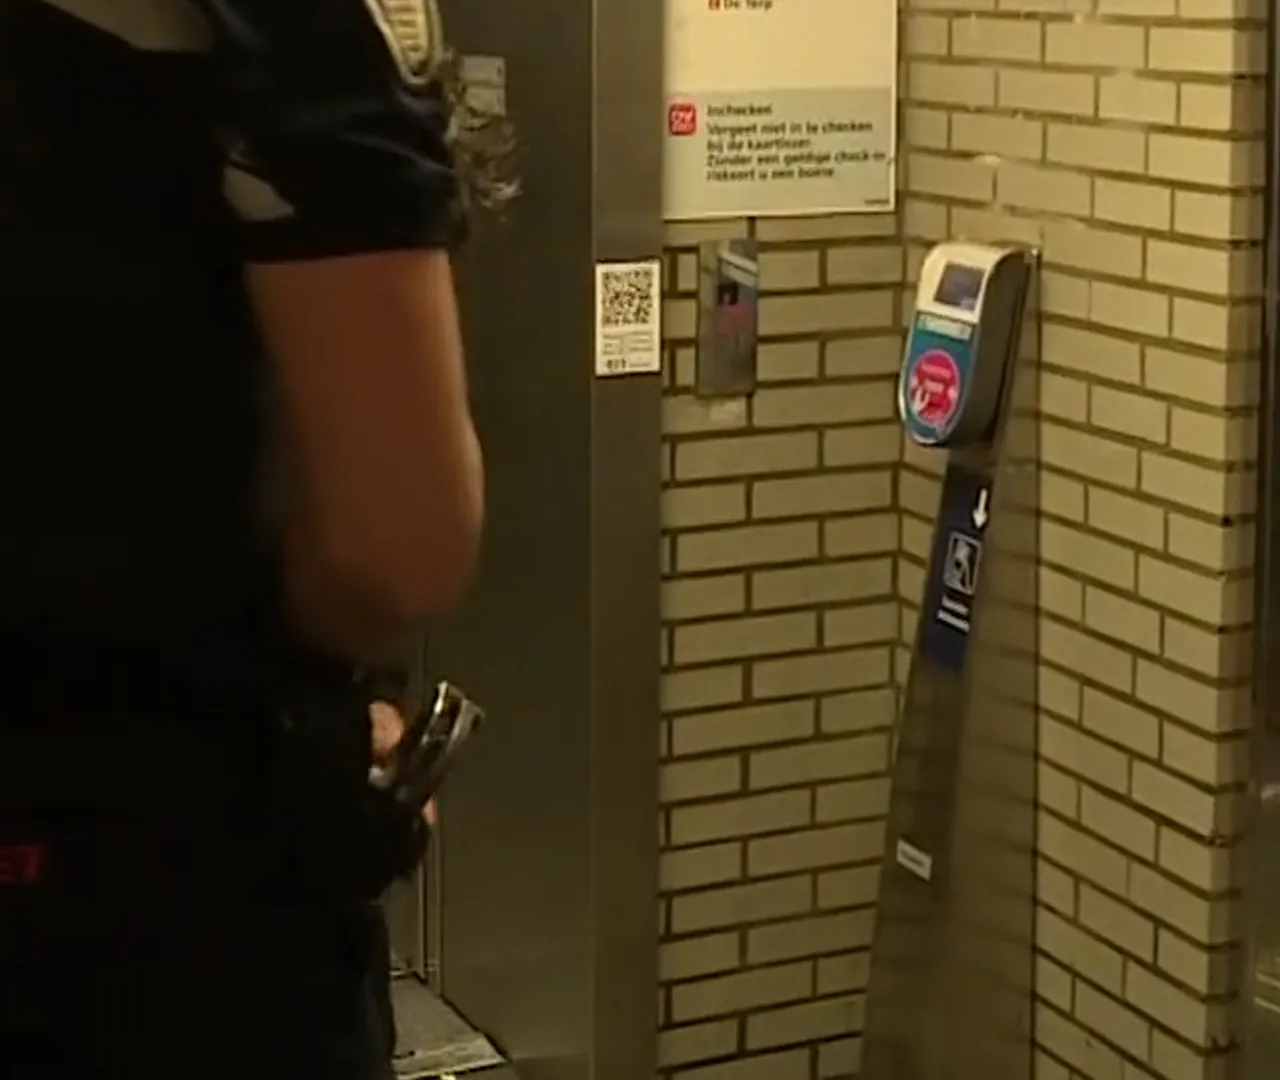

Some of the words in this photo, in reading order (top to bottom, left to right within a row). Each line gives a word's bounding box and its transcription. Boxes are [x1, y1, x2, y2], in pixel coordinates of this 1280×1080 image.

[707, 104, 773, 117] Inchecken
[707, 123, 757, 137] Vergeet
[761, 122, 786, 134] niet
[790, 122, 803, 133] in
[806, 122, 818, 134] te
[822, 120, 873, 134] checken
[707, 140, 723, 152] bij
[727, 139, 744, 151] de
[707, 155, 752, 167] Zonder
[757, 154, 780, 164] een
[771, 169, 794, 180] een
